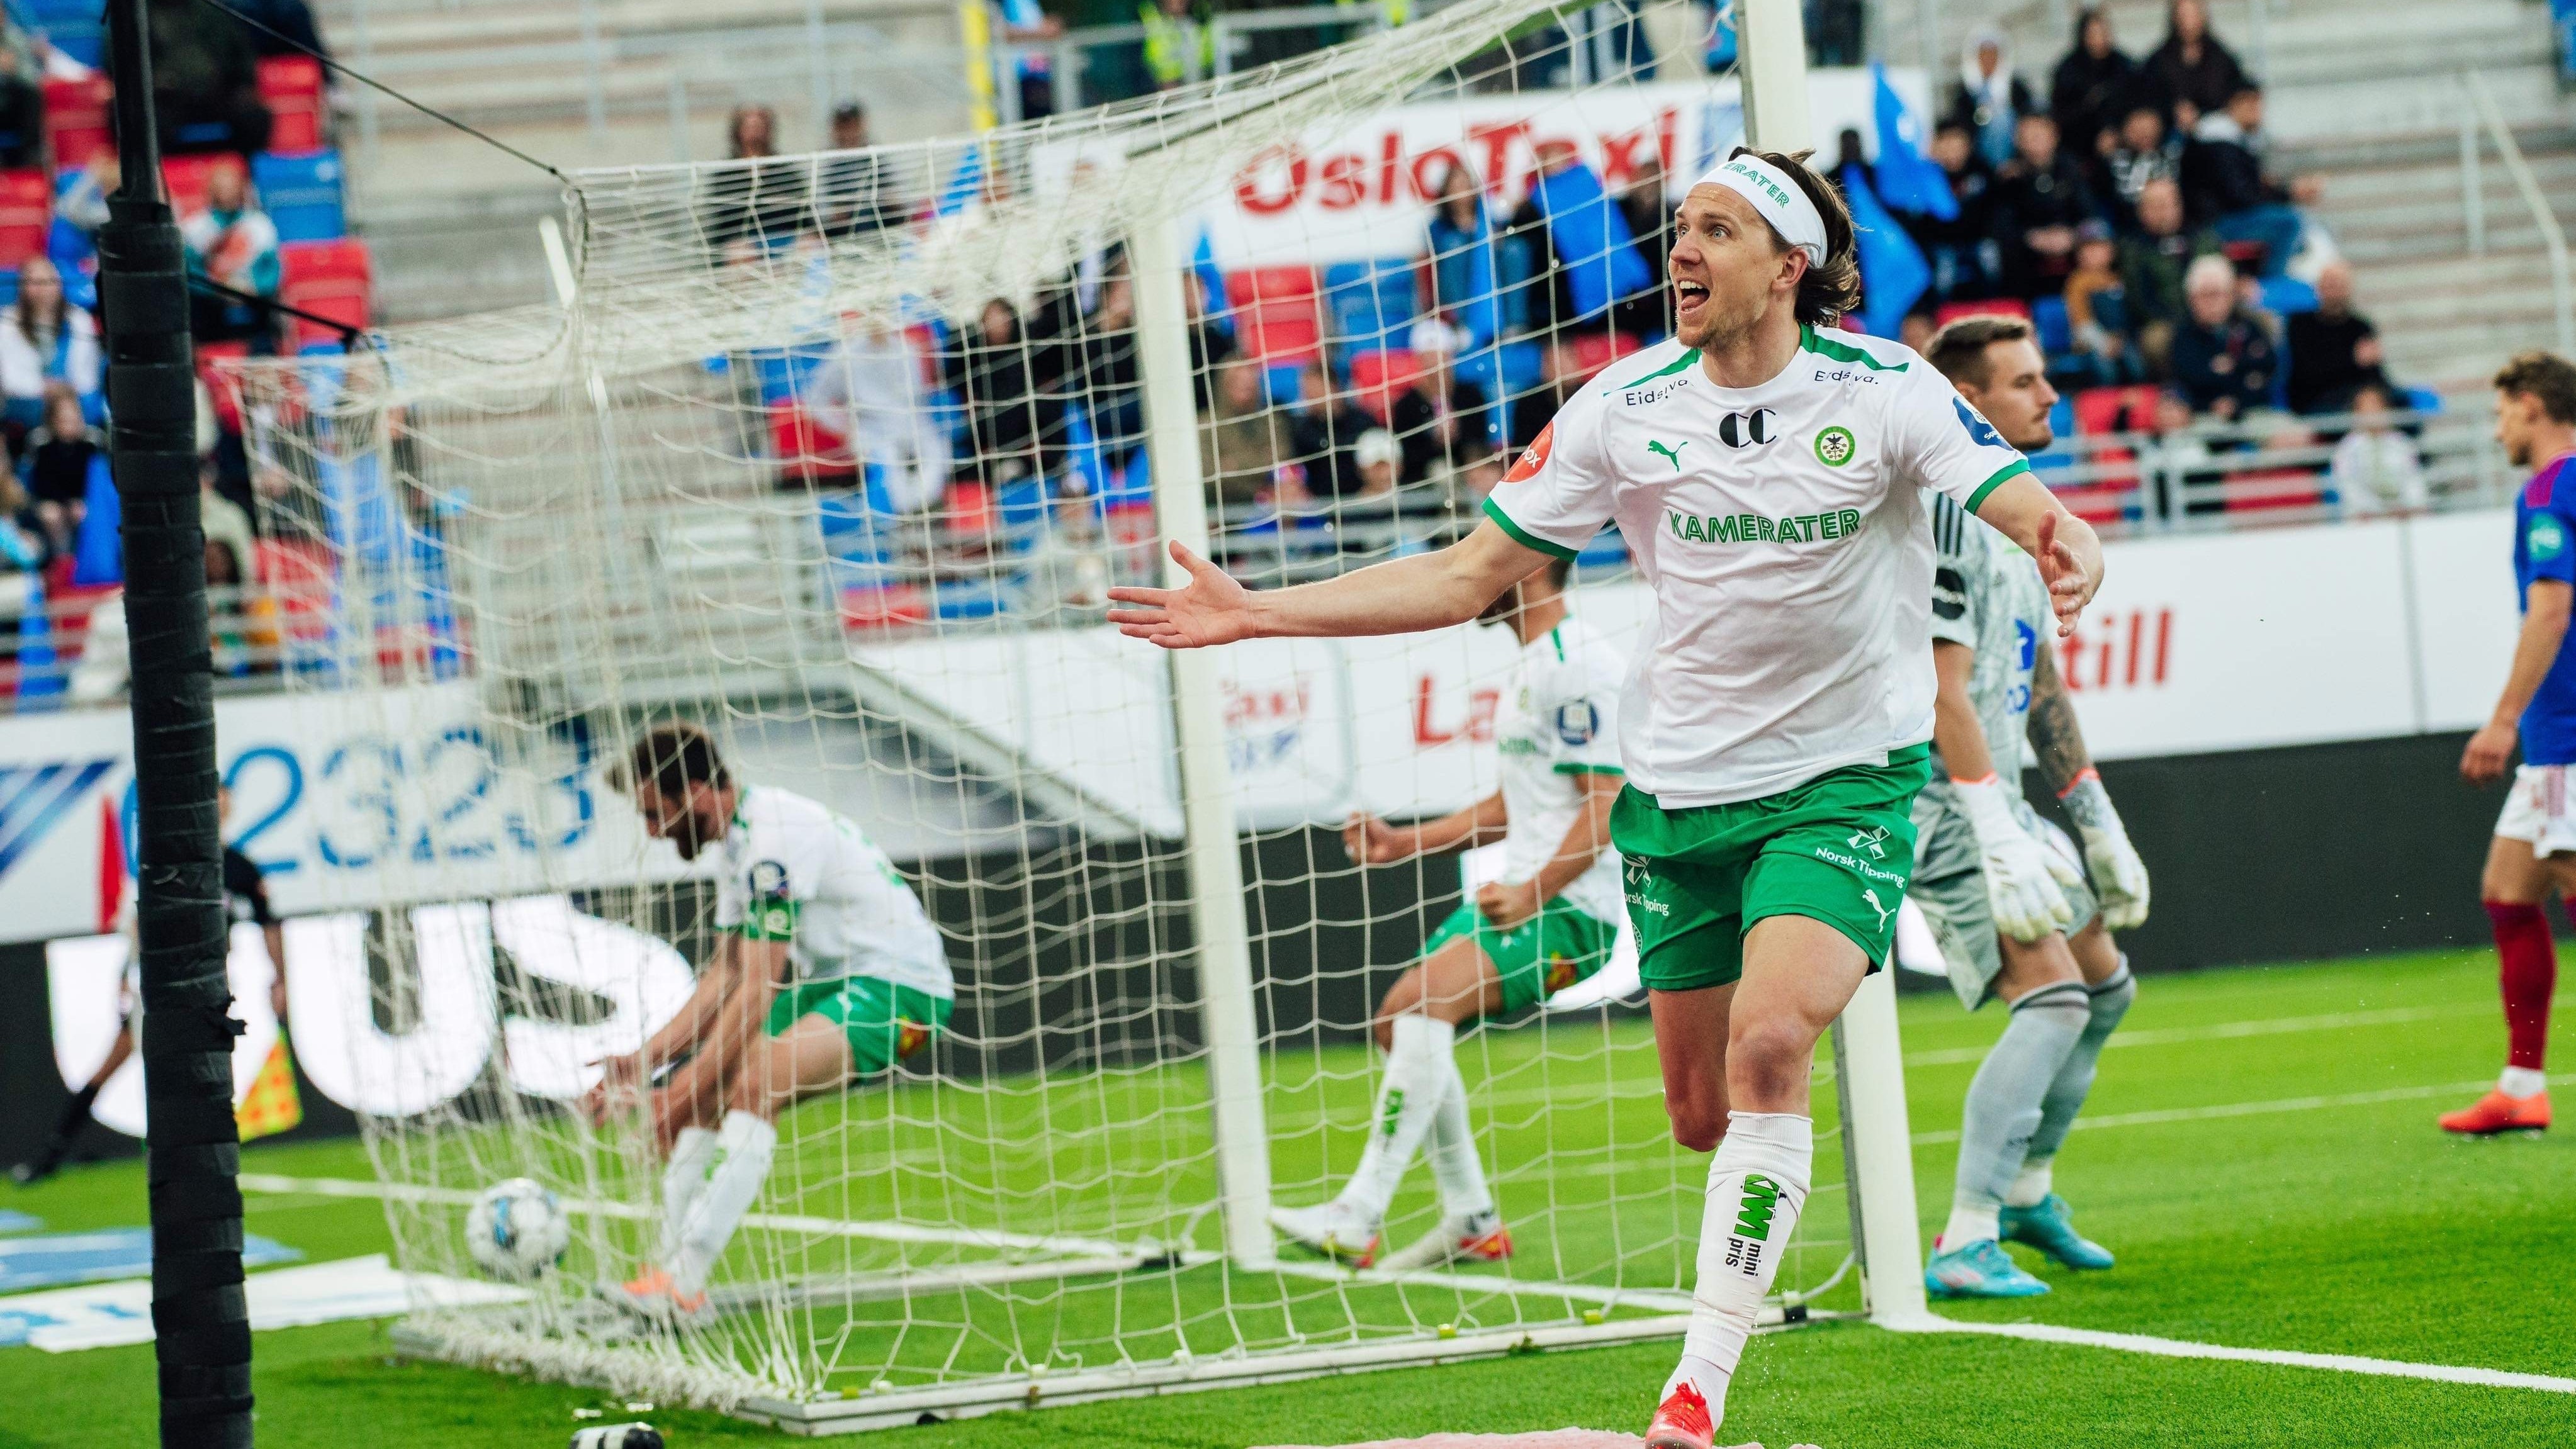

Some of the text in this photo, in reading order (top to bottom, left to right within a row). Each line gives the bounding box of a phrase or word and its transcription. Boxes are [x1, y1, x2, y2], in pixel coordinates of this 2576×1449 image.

[1667, 508, 1860, 544] KAMERATER
[120, 715, 595, 880] 2323
[1815, 847, 1905, 889] Norsk Tipping
[1724, 1236, 1745, 1268] pris
[1743, 1243, 1762, 1277] mini
